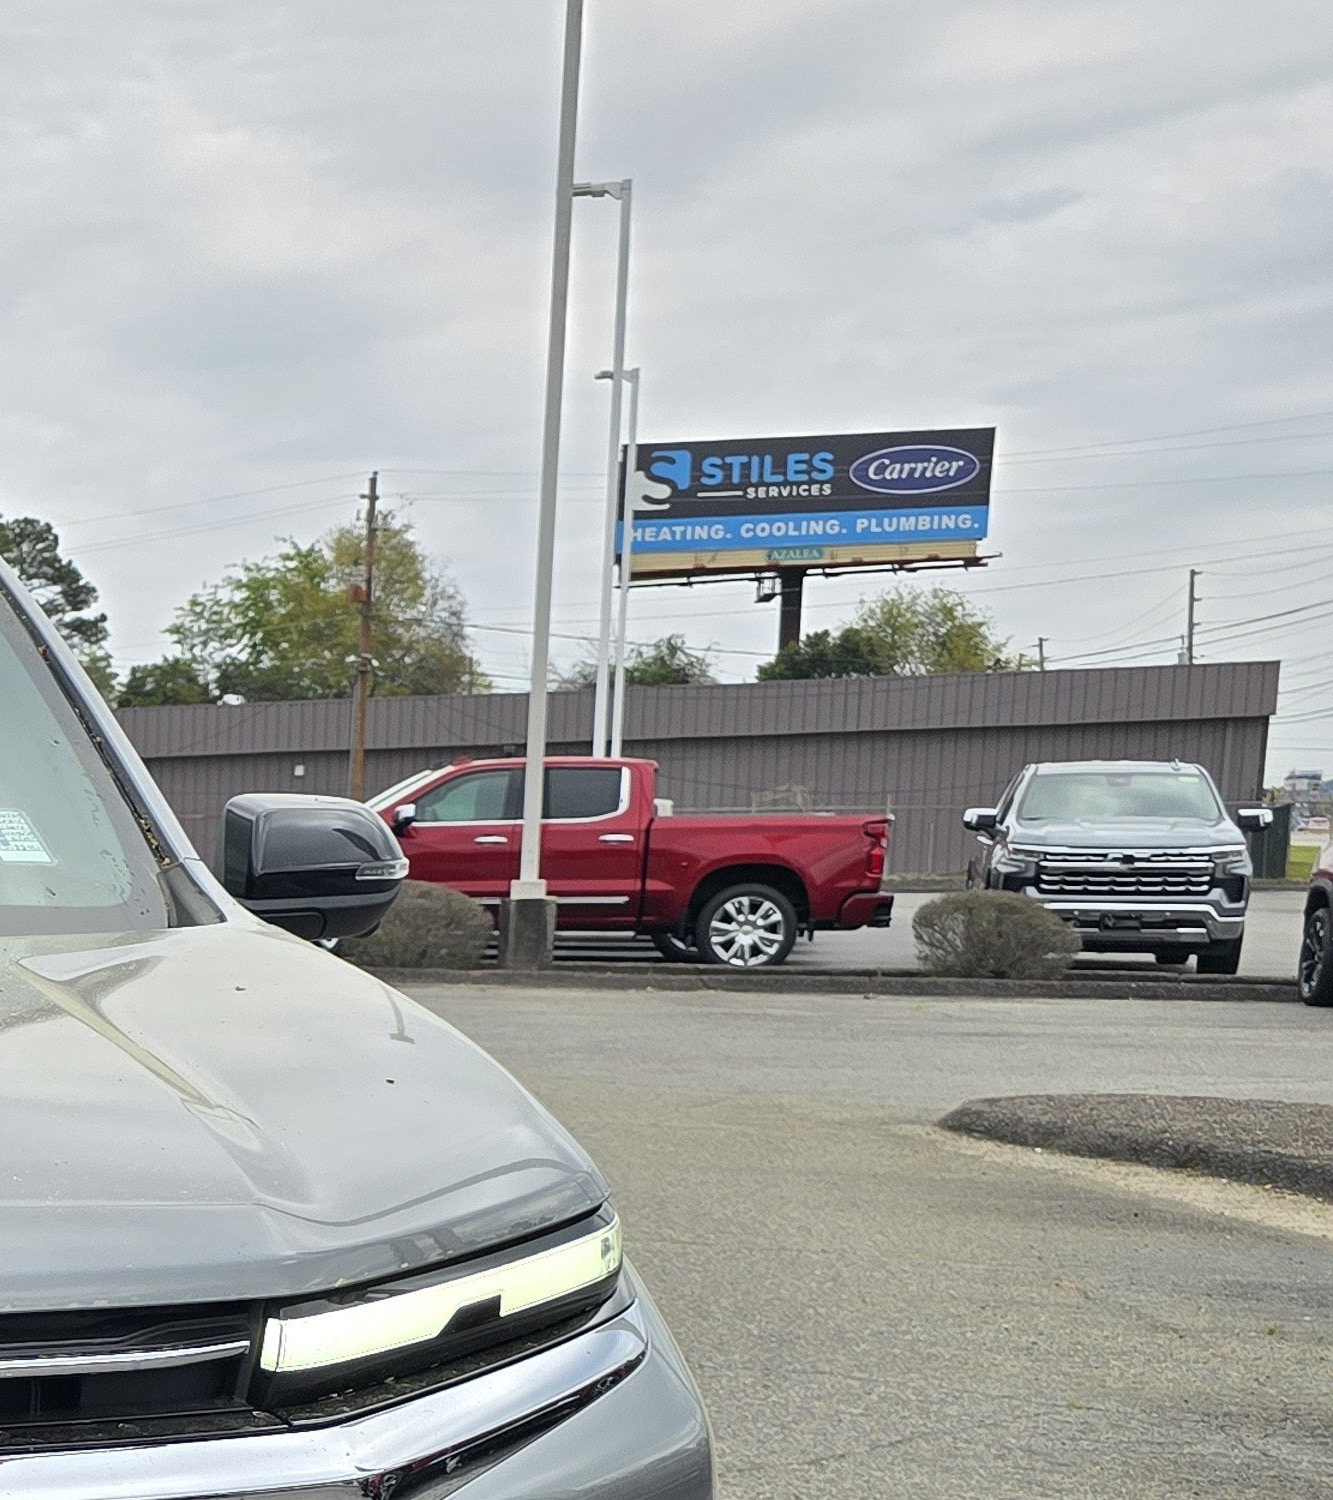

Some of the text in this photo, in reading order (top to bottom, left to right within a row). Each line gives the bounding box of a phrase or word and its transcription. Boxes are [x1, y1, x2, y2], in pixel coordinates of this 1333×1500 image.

[700, 452, 835, 486] STILES
[868, 456, 964, 480] Carrier
[746, 483, 832, 499] SERVICES
[631, 514, 979, 542] HEATING. COOLING. PLUMBING.
